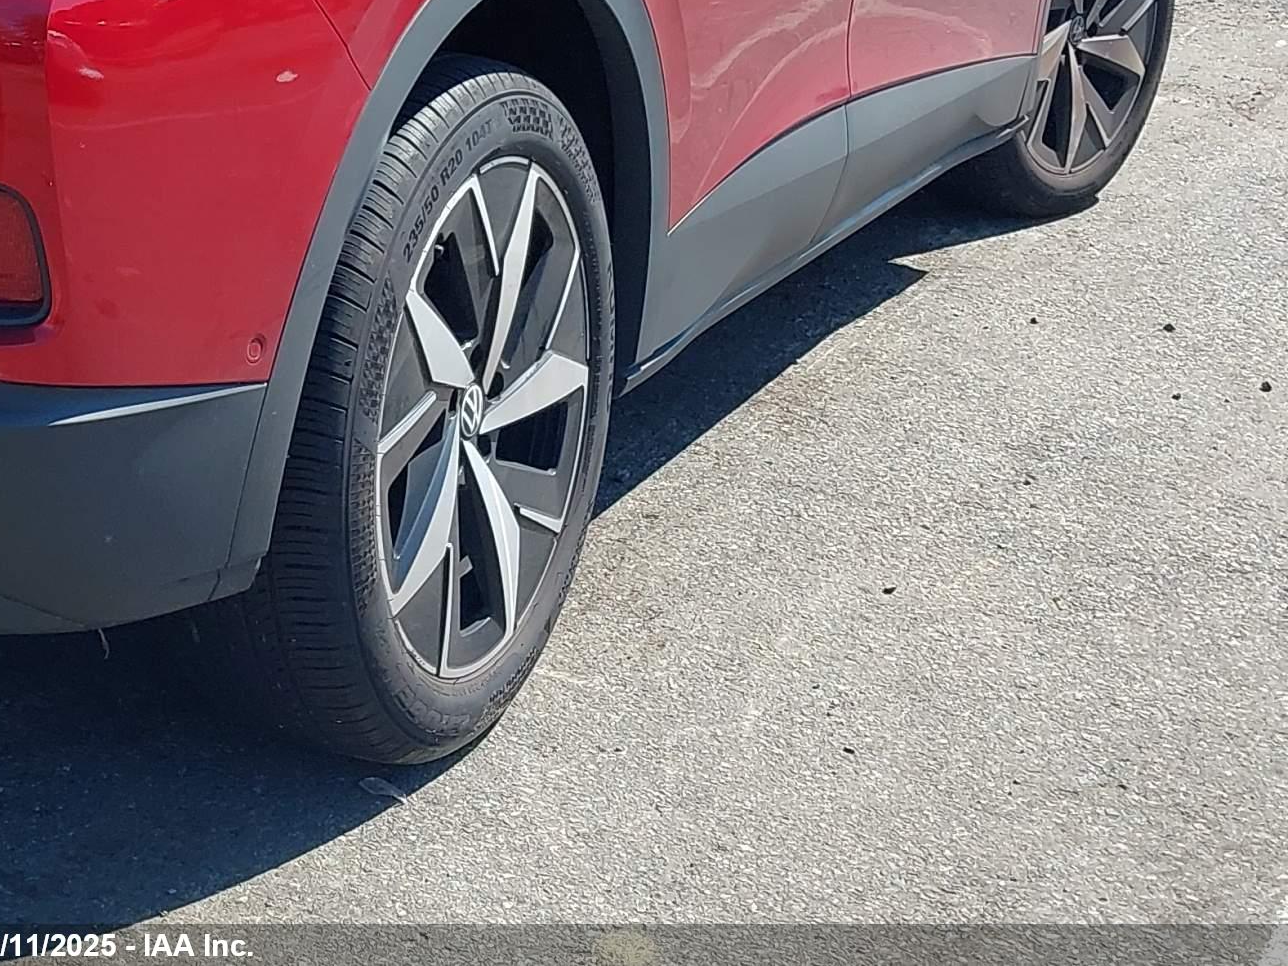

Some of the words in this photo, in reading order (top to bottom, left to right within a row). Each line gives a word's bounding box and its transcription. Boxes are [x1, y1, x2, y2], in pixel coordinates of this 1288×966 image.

[403, 185, 440, 264] 235/50
[439, 148, 463, 187] R20
[464, 118, 493, 152] 104T
